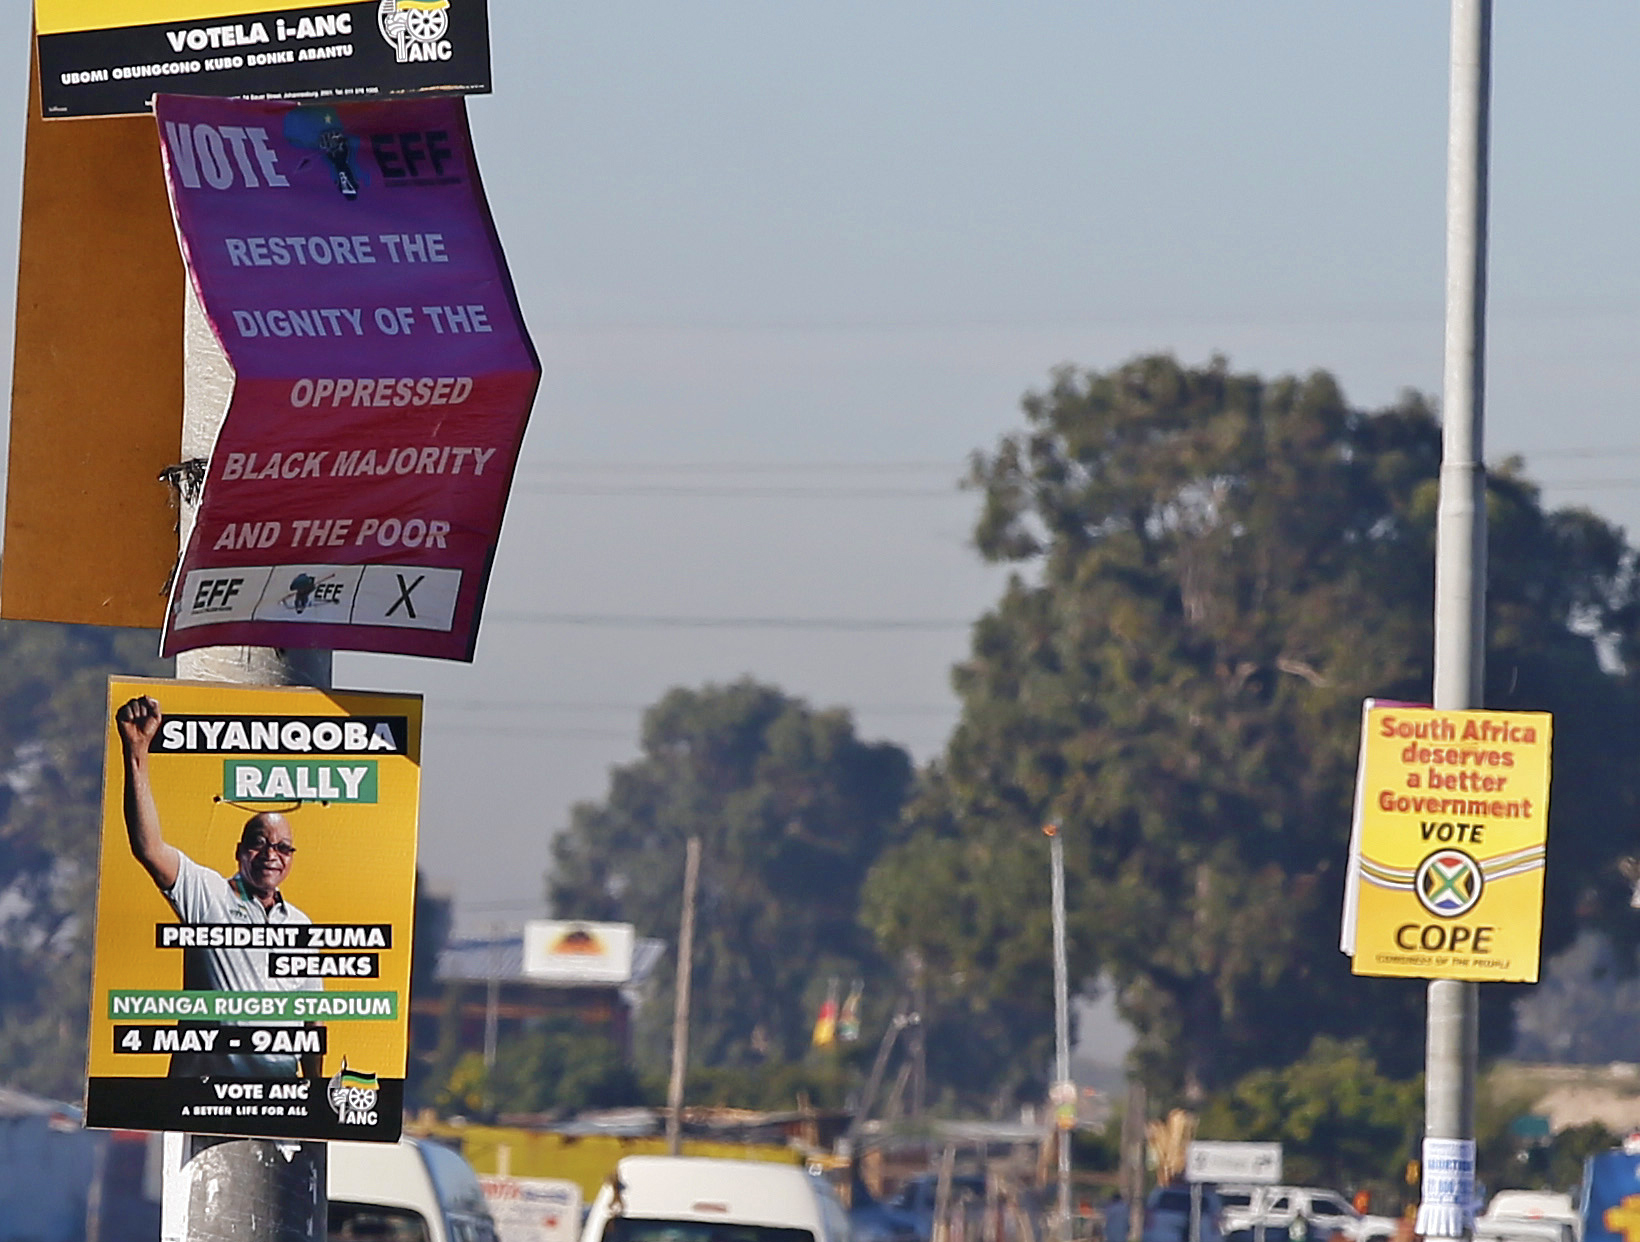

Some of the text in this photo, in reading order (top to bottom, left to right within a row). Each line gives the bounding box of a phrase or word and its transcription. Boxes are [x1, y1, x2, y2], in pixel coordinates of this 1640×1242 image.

[166, 13, 352, 52] VOTELA i-ANC
[61, 44, 354, 85] UBOMI OBUNGCONO KUBO BONKE ABANTU
[408, 42, 452, 61] ANC
[164, 120, 291, 189] VOTE
[371, 131, 453, 178] EFF
[225, 233, 449, 267] RESTORE THE
[233, 305, 493, 338] DIGNITY OF THE
[290, 377, 474, 408] OPPRESSED
[221, 447, 496, 481] BLACK MAJORITY
[214, 519, 450, 551] AND THE POOR
[193, 578, 244, 609] EFF
[314, 584, 344, 600] EFF
[162, 721, 397, 752] SIYANQOBA
[1380, 716, 1537, 743] South Africa
[1402, 741, 1515, 767] deserves
[235, 765, 369, 799] RALLY
[1407, 768, 1508, 792] a better
[1379, 791, 1533, 818] Government
[1421, 821, 1484, 844] VOTE
[163, 927, 386, 947] PRESIDENT ZUMA
[1396, 924, 1495, 953] COPE
[275, 957, 371, 976] SPEAKS
[113, 996, 391, 1016] NYANGA RUGBY STADIUM
[122, 1029, 142, 1050] 4
[153, 1029, 219, 1051] MAY
[251, 1030, 320, 1052] 9AM
[214, 1083, 309, 1100] VOTE ANC
[181, 1105, 308, 1117] A BETTER LIFE FOR ALL
[346, 1111, 378, 1126] ANC
